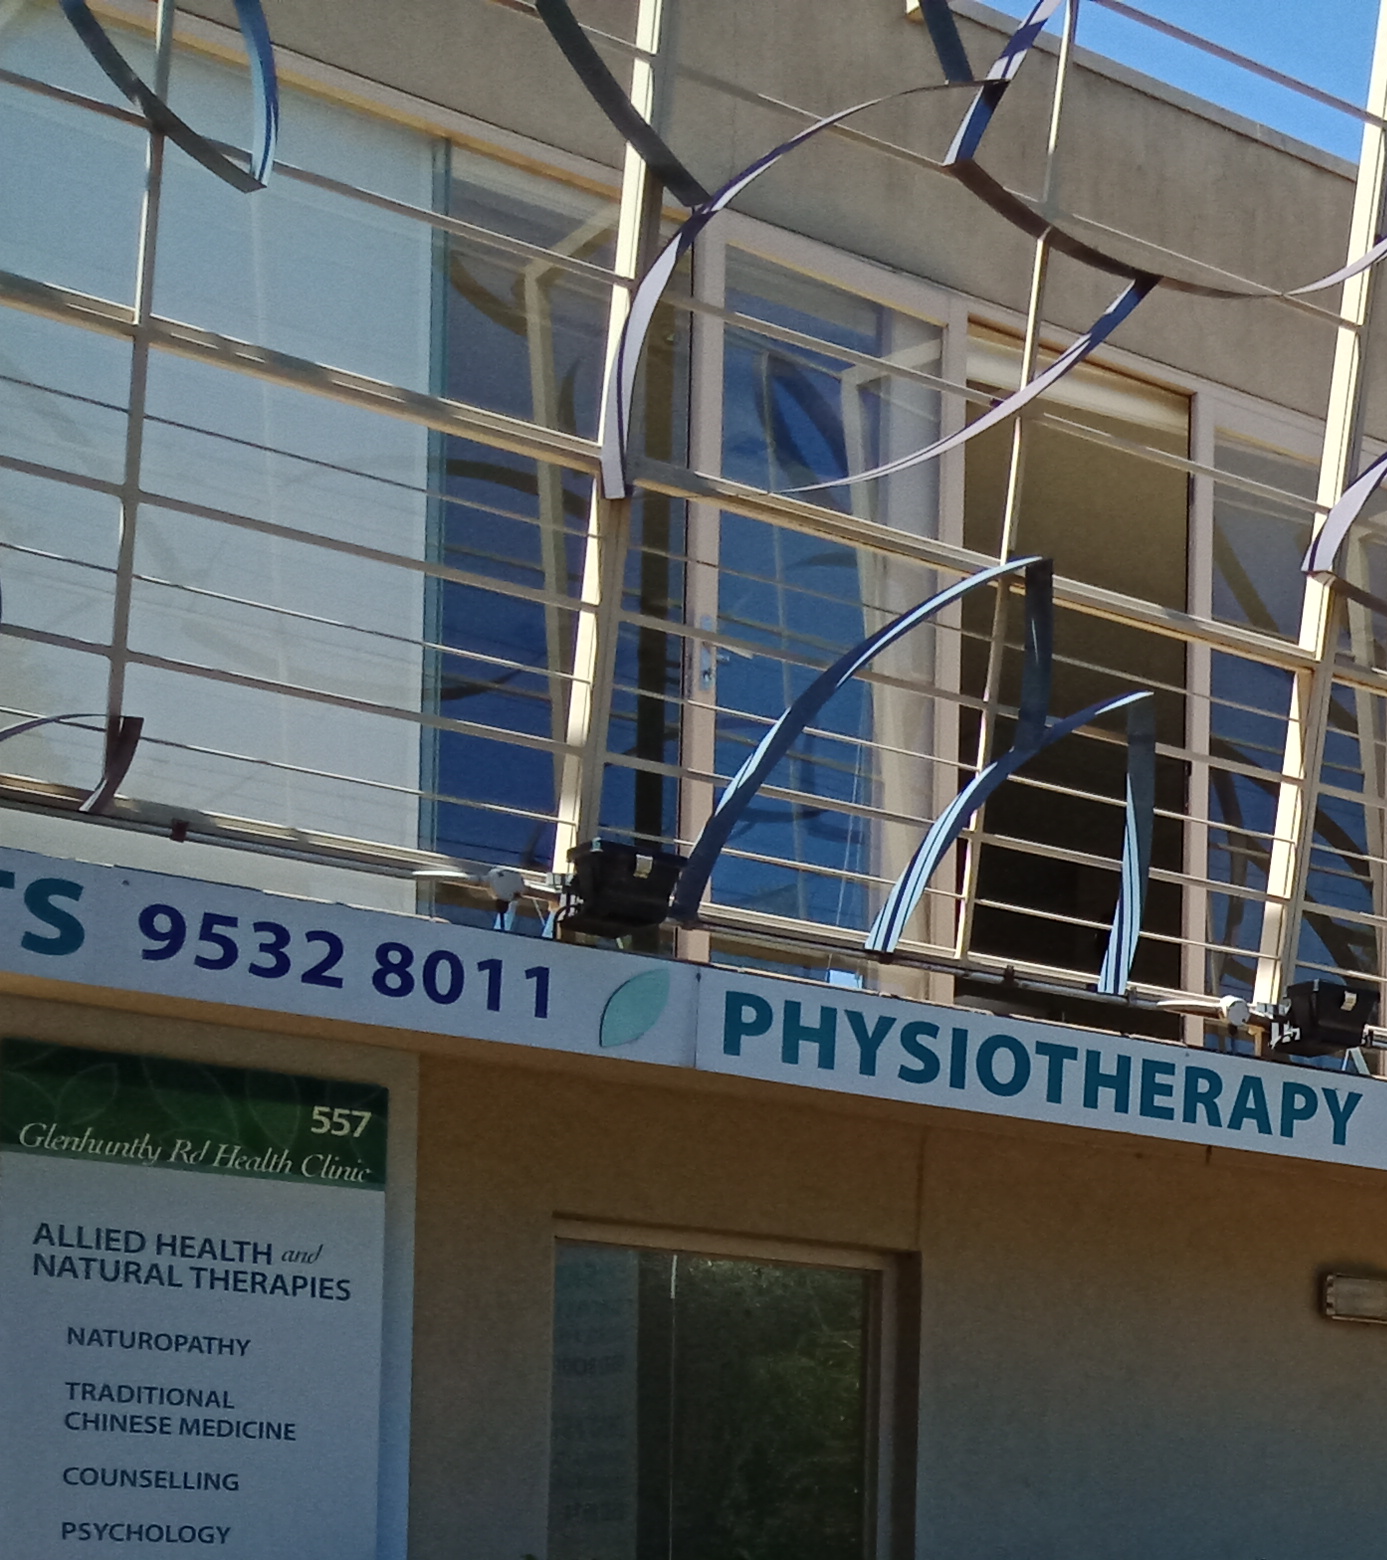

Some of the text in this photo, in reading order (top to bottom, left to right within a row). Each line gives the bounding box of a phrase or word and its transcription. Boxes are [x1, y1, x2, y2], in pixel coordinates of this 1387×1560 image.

[0, 870, 549, 1018] S 9532 8011
[723, 990, 1363, 1146] PHYSIOTHERAPY
[311, 1106, 371, 1137] 557
[18, 1122, 373, 1183] Glenhuntly Rd Health Clinic
[33, 1222, 324, 1265] ALLIED HEALTH and
[33, 1253, 351, 1301] NATURAL THERAPIES
[67, 1327, 251, 1356] NATUROPATHY
[65, 1382, 235, 1409] TRADITIONAL
[64, 1411, 296, 1442] CHINESE MEDICINE
[62, 1466, 240, 1492] COUNSELLING
[61, 1522, 231, 1545] PSYCHOLOGY
